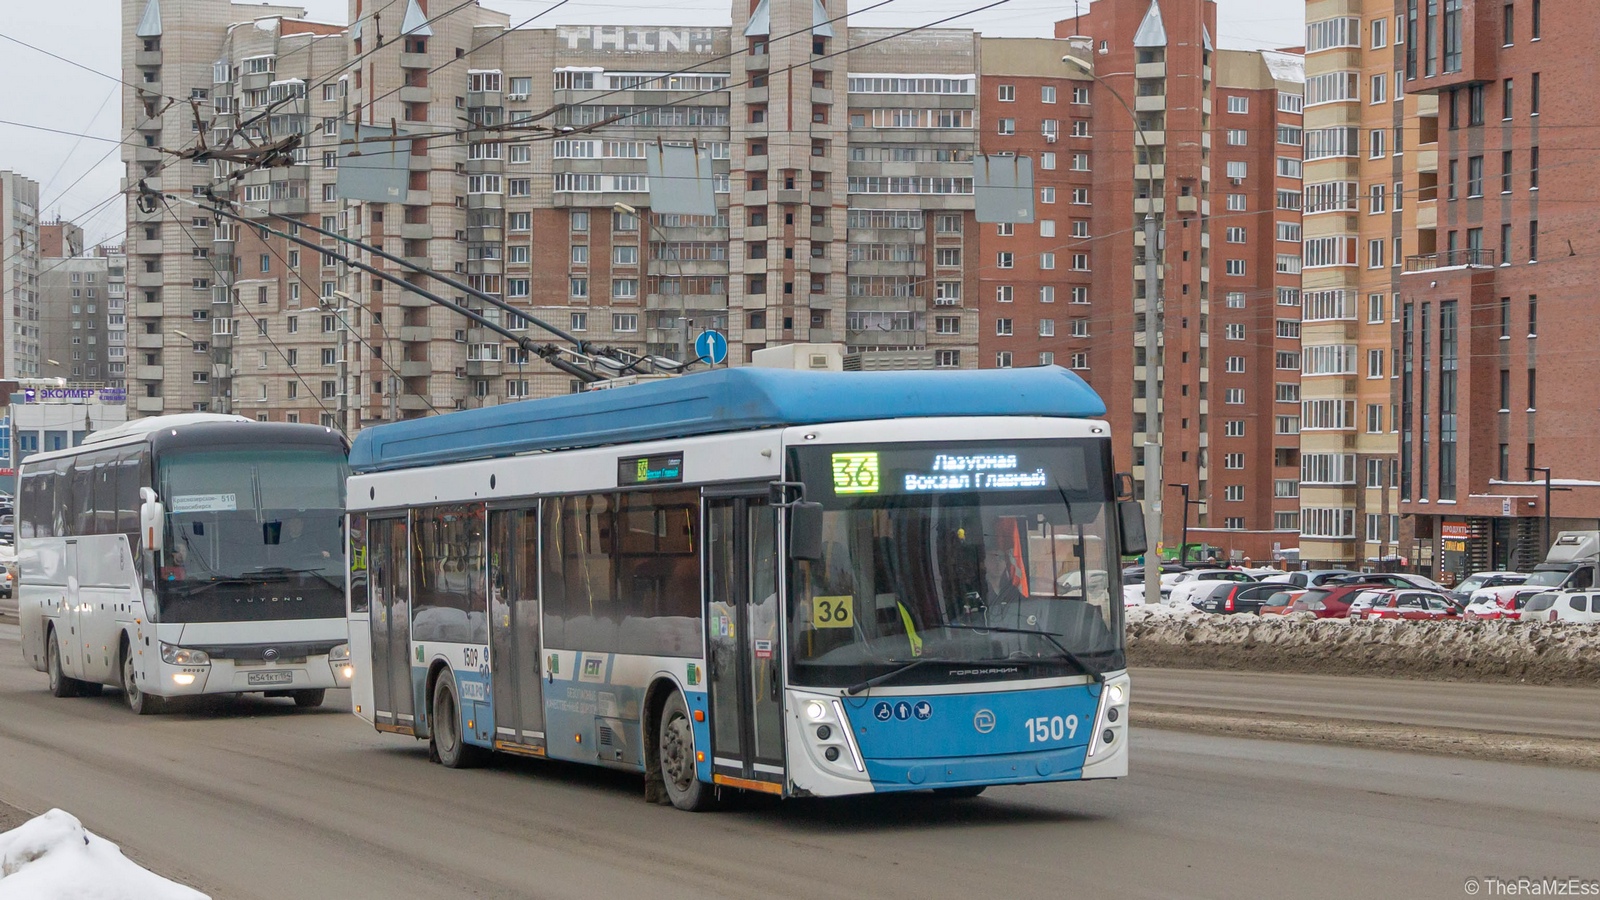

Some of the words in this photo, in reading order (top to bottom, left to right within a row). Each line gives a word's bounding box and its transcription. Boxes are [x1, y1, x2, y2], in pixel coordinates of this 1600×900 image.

[40, 389, 95, 398] ЭКСИМЕР
[834, 456, 875, 488] 36
[932, 454, 1018, 471] Лазурная
[904, 474, 970, 490] Вокзал
[974, 468, 1047, 488] Главный
[818, 601, 848, 623] 36
[463, 648, 478, 667] 1509
[949, 667, 1018, 676] ГОРОЖАНИН
[1025, 714, 1079, 743] 1509
